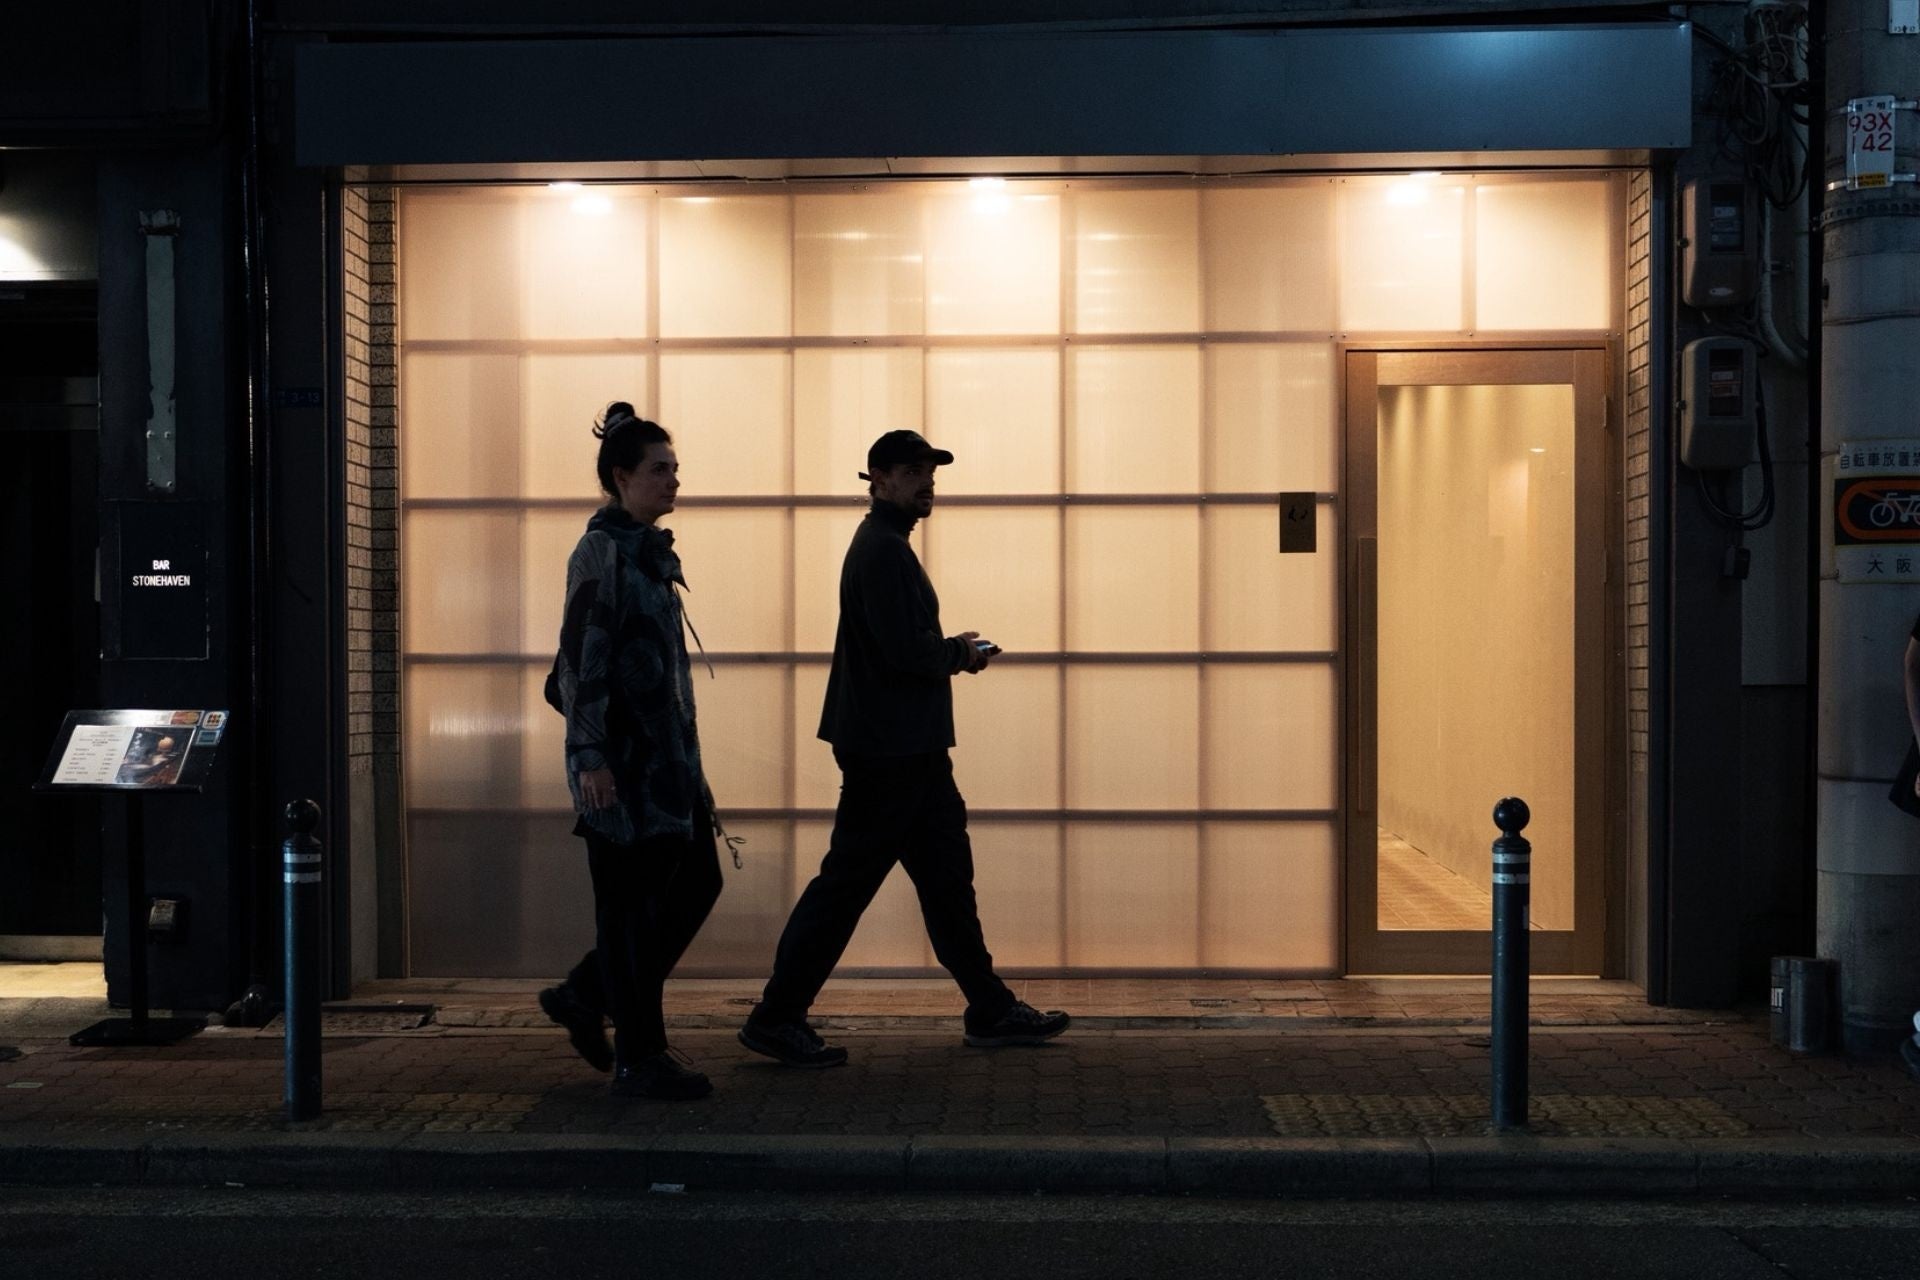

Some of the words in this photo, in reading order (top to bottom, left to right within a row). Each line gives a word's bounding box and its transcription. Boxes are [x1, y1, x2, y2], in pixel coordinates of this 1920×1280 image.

[1849, 112, 1892, 133] 93X
[153, 560, 170, 570] BAR
[1867, 558, 1912, 574] 大阪
[132, 575, 191, 587] STONEHAVEN
